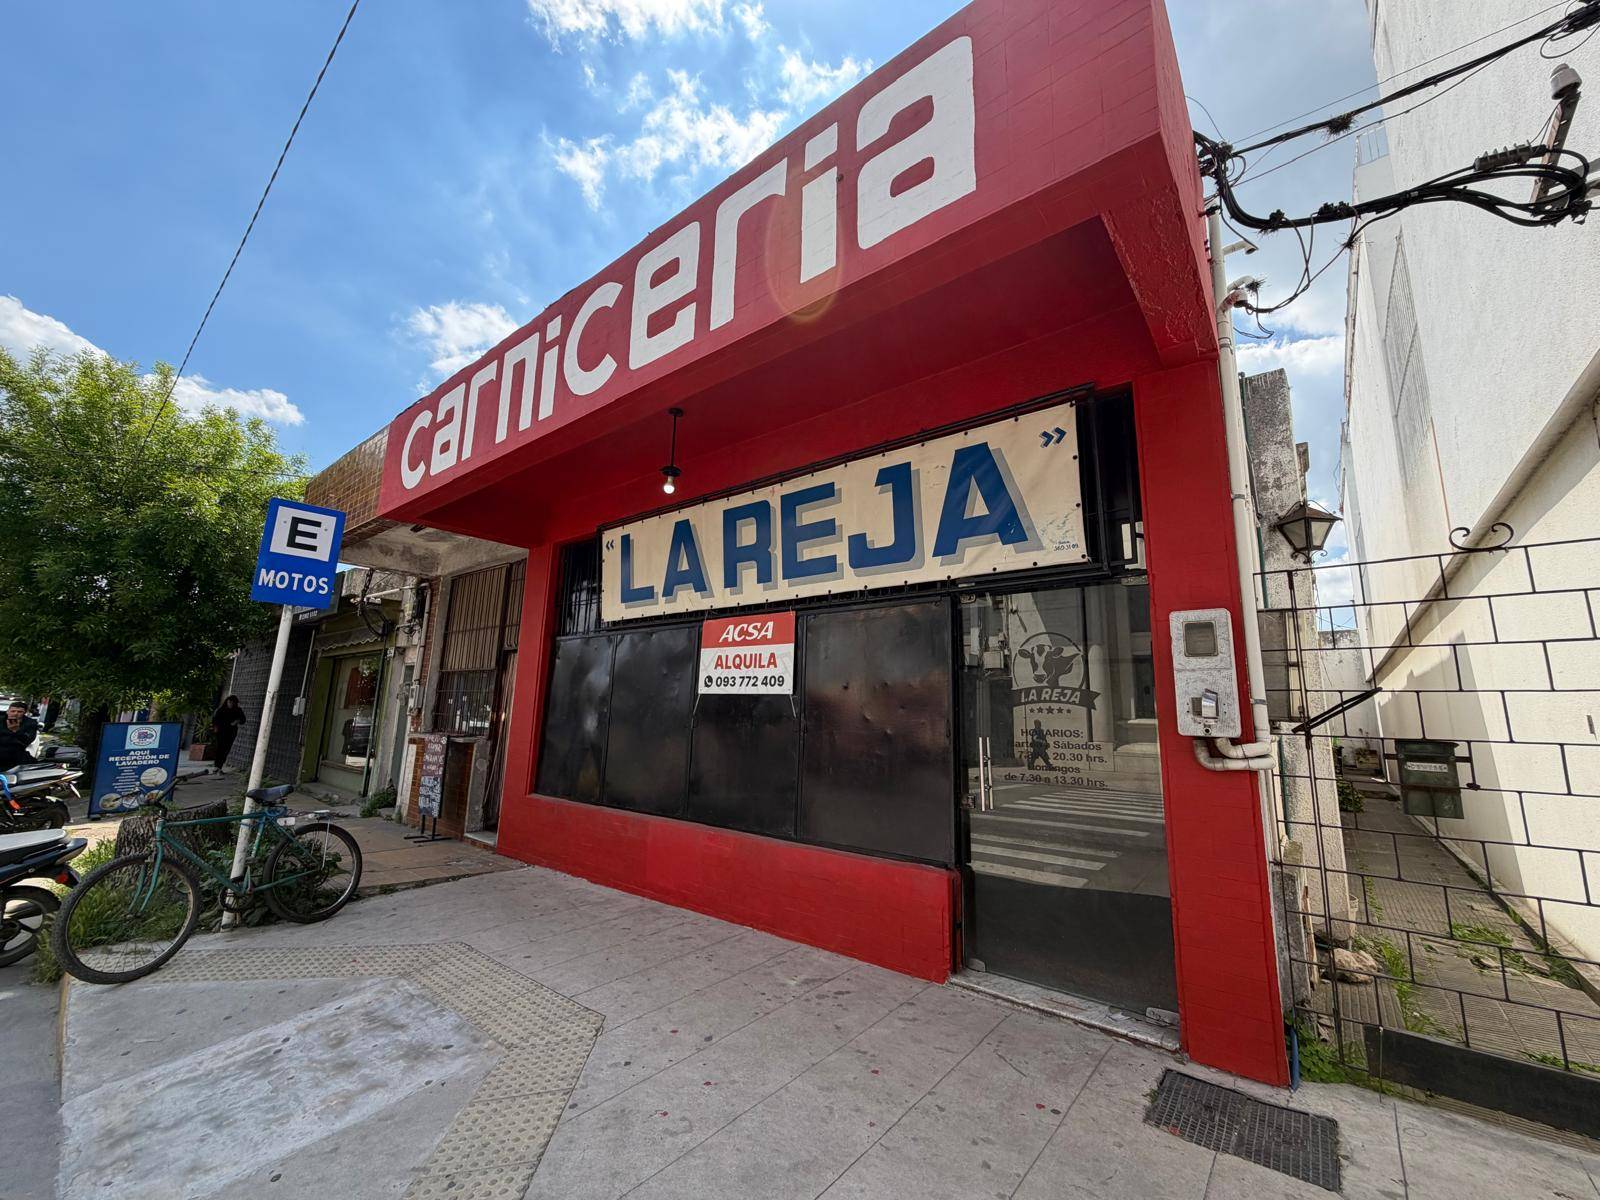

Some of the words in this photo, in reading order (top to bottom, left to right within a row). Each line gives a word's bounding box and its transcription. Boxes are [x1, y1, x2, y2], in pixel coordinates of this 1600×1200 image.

[400, 36, 977, 490] carniceria
[287, 516, 322, 552] E
[258, 568, 329, 595] MOTOS
[719, 621, 774, 643] ACSA
[714, 653, 778, 670] ALQUILA
[715, 676, 737, 687] 093
[739, 675, 759, 687] 772
[760, 675, 785, 687] 409
[1020, 689, 1037, 703] LA
[1041, 688, 1081, 704] REJA
[1021, 729, 1084, 739] HOARIOS:
[1053, 740, 1102, 751] Sábados
[1052, 752, 1083, 761] 20.30
[1086, 753, 1108, 764] hrs.
[1004, 772, 1017, 781] de
[1020, 773, 1041, 783] 7.30
[1054, 776, 1084, 786] 13.30
[1086, 778, 1109, 788] hrs.
